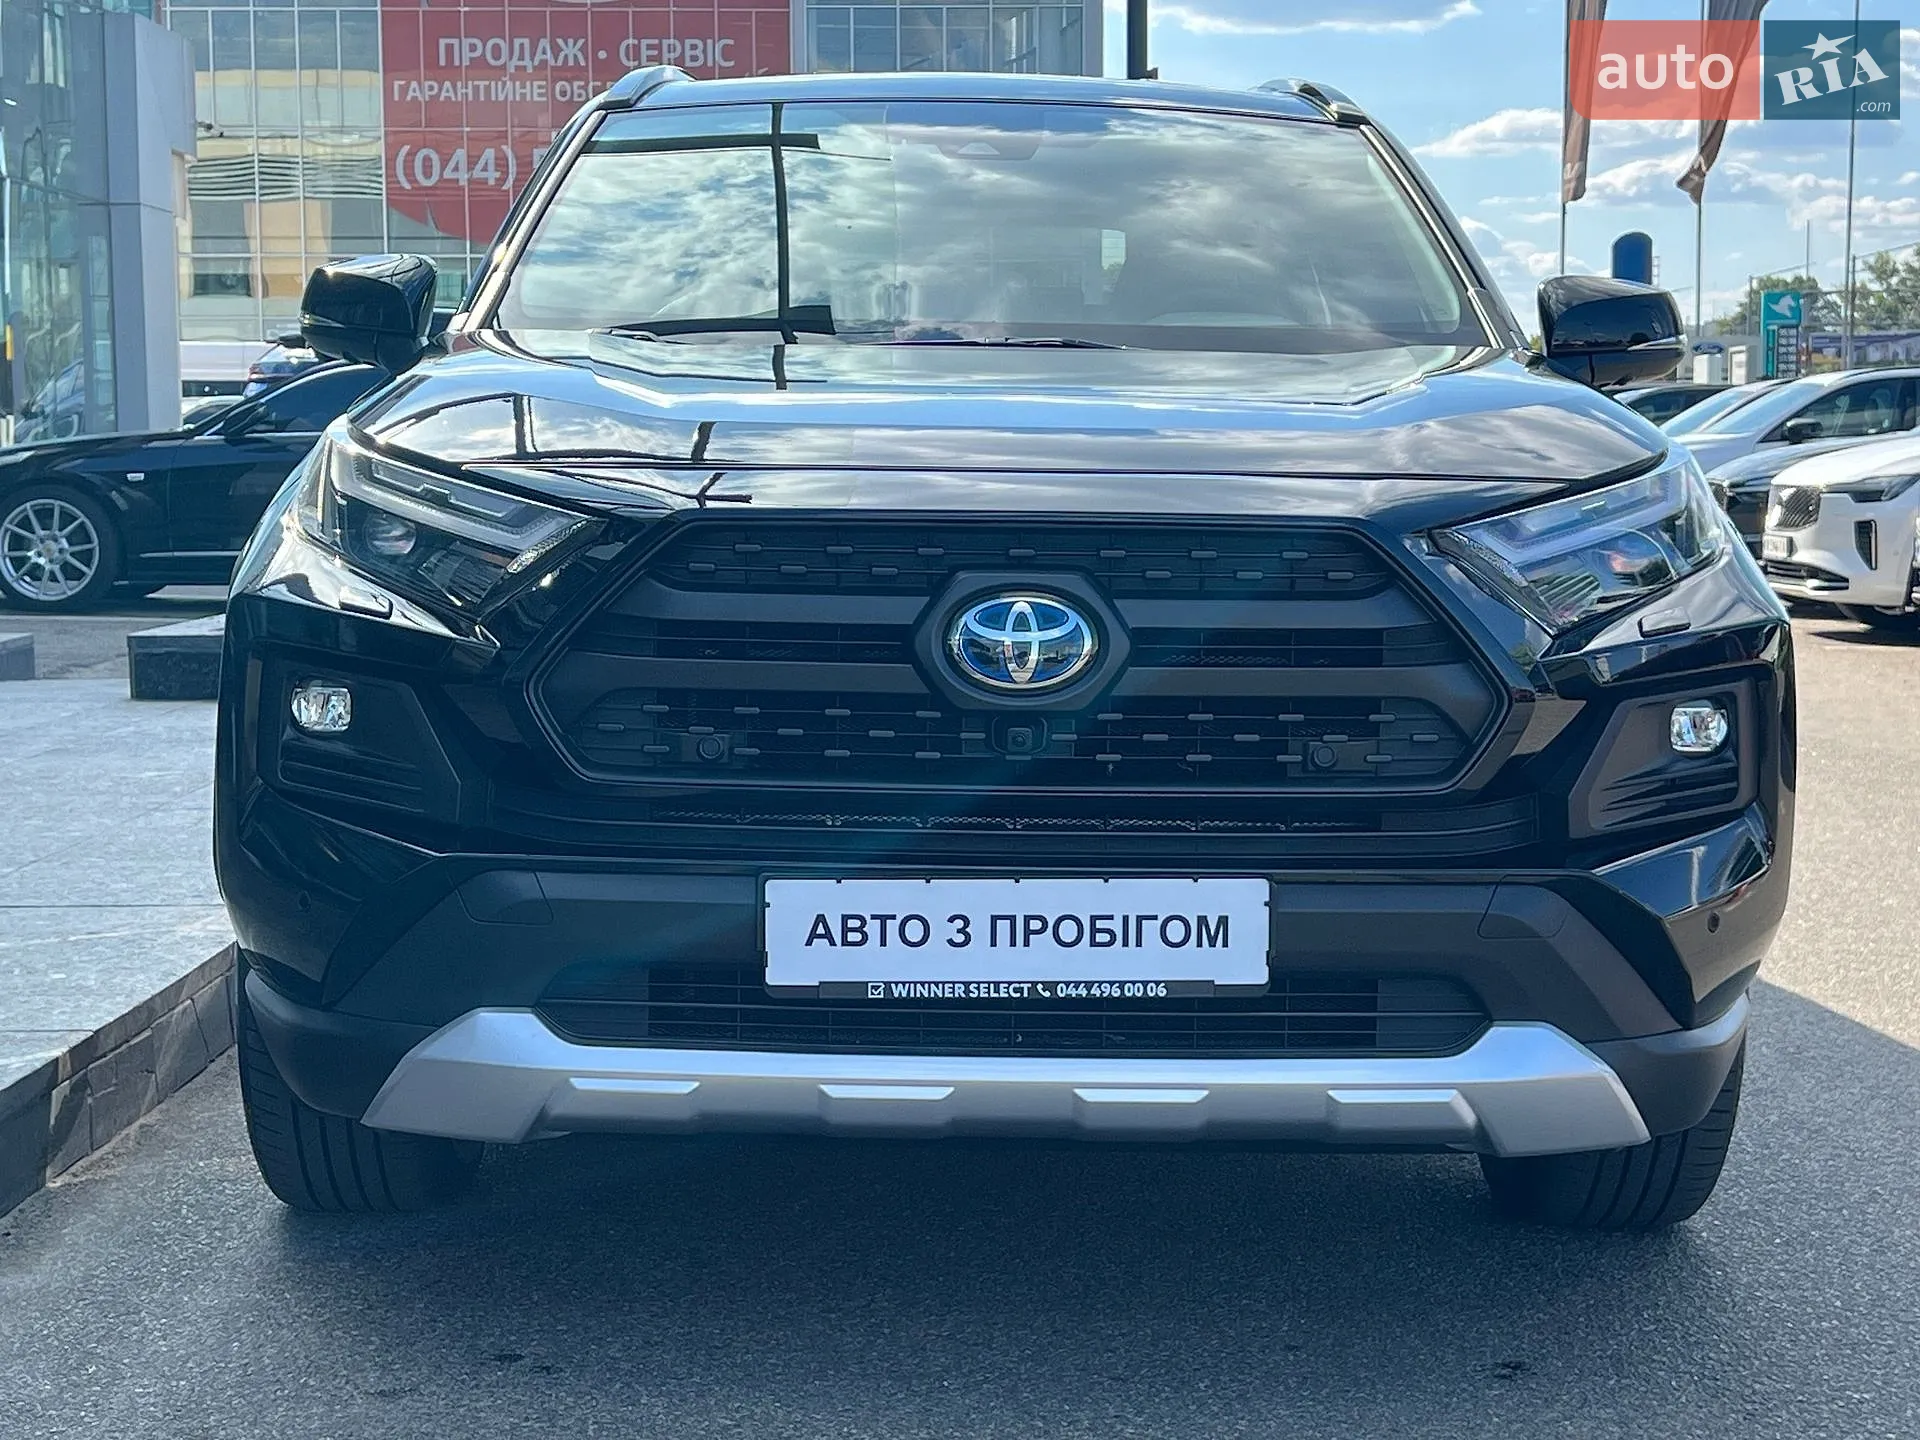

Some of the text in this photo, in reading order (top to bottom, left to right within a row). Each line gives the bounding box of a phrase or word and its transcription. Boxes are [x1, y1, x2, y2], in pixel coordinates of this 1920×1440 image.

[438, 37, 736, 71] ПРОДАЖ СЕРВІС
[392, 75, 616, 102] ГАРАНТІЙНЕ ОБС
[395, 144, 517, 190] (044)
[804, 913, 932, 948] АВТО
[988, 913, 1231, 948] ПРОБІГОМ
[890, 982, 1168, 998] WINNER SELECT 044 496 00 06
